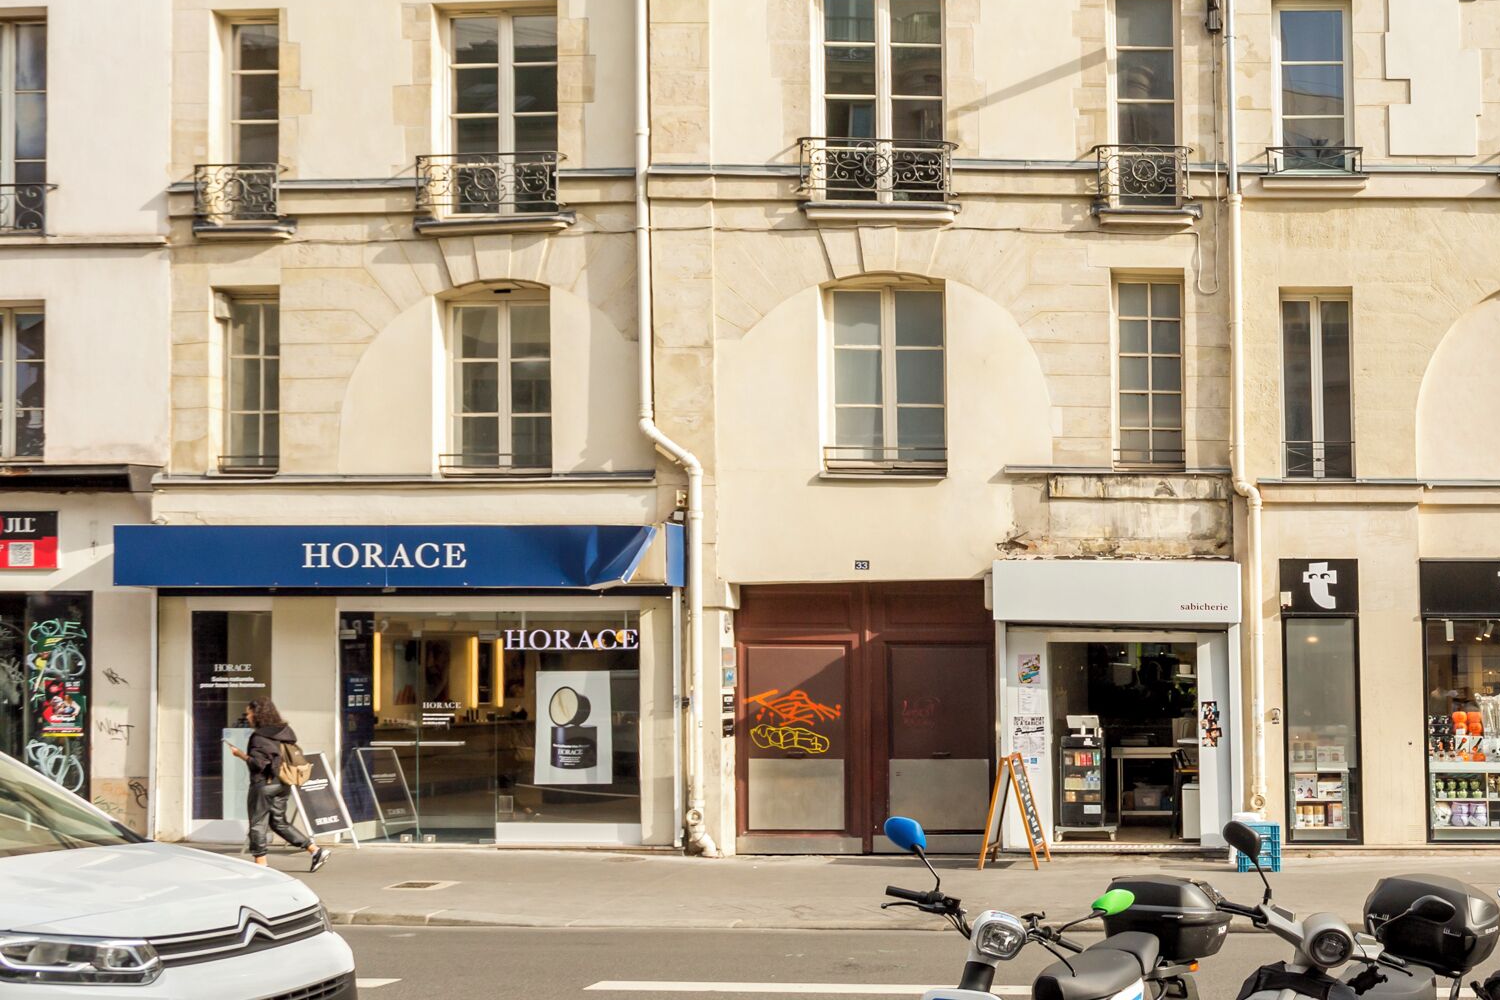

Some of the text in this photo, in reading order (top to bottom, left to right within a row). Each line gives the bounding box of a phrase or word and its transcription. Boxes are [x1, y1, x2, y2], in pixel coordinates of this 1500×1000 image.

[302, 542, 467, 568] HORACE
[856, 561, 868, 570] 33
[1180, 602, 1229, 611] sabicherie
[504, 628, 639, 650] HORACE
[214, 663, 253, 672] HORACE
[422, 701, 462, 709] HORACE
